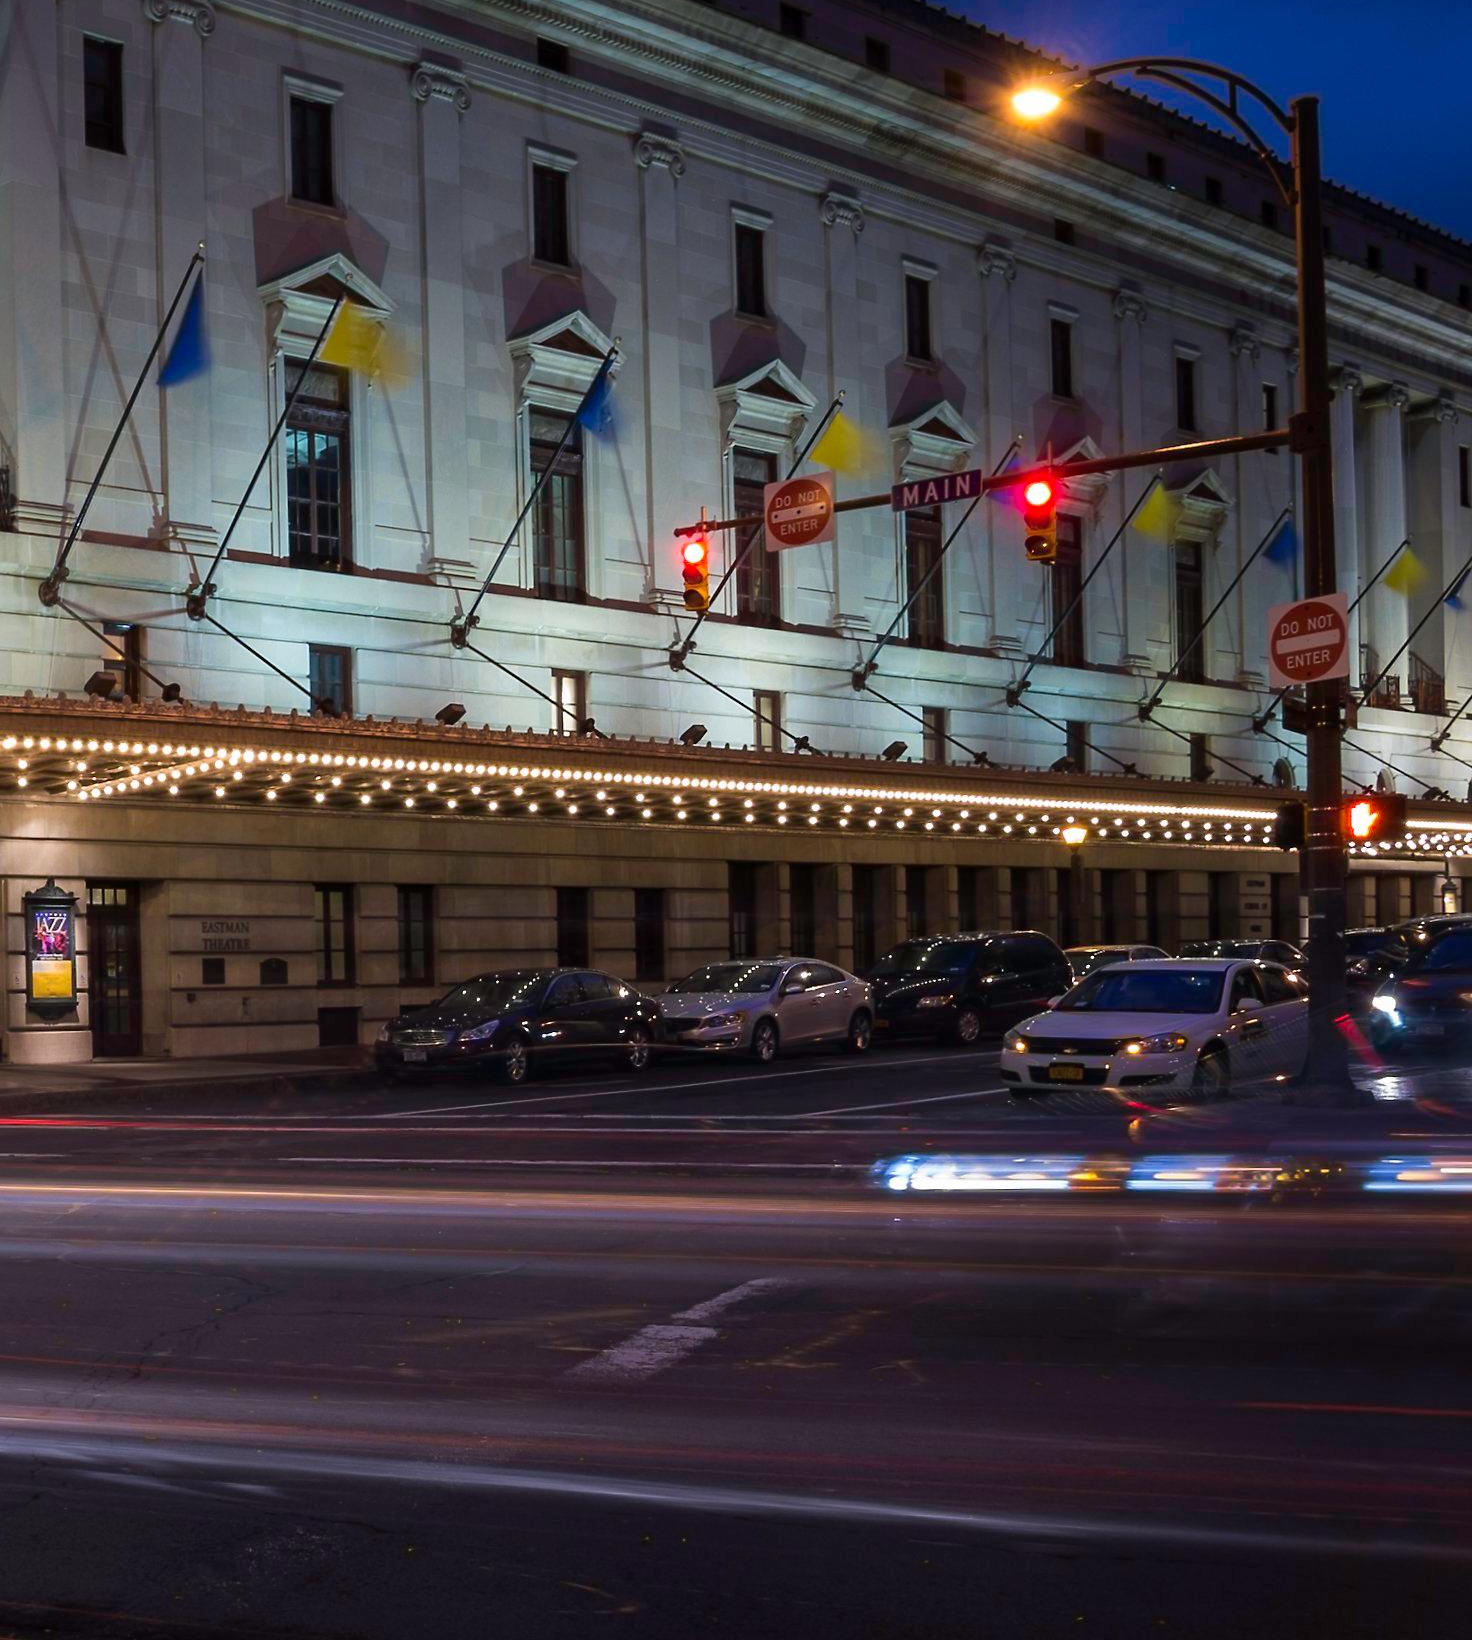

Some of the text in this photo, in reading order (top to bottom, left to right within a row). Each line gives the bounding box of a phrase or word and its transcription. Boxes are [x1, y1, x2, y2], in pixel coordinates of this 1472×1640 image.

[776, 489, 821, 508] DO NOT
[903, 474, 970, 507] MAIN
[780, 519, 817, 536] ENTER
[1281, 613, 1334, 636] DO NOT
[1286, 649, 1330, 669] ENTER
[36, 916, 67, 934] JAZZ
[201, 921, 250, 934] EASTMAN
[202, 938, 250, 950] THEATRE
